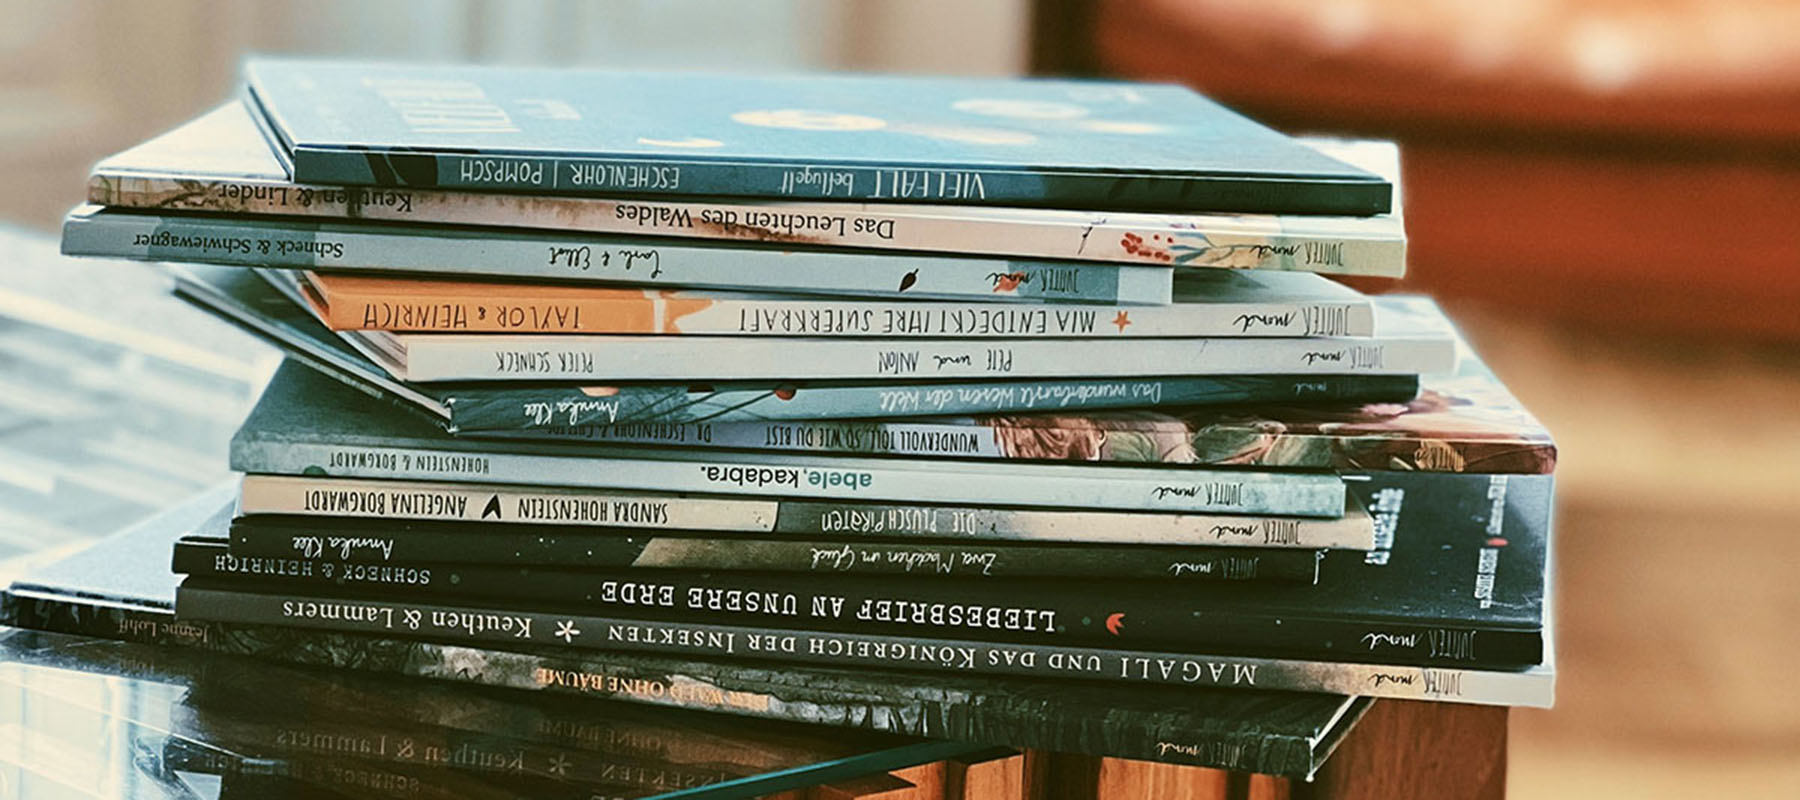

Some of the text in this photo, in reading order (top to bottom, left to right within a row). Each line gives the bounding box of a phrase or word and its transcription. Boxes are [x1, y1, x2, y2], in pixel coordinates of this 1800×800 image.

[460, 159, 680, 189] ESCHENLOHR POMPSCH
[867, 170, 985, 200] VIELFALT
[216, 184, 288, 207] Linder
[295, 187, 314, 208] &
[614, 204, 896, 240] Das Leuchten des Waldes
[132, 231, 344, 259] Schneck & Schwiewagner
[549, 246, 591, 271] Elliot
[362, 303, 581, 329] TAYLOR & HEINRICH
[738, 308, 1097, 334] MIA ENTDECKT IHRE SUPERKRAFT
[495, 352, 594, 374] PETER SCHNECK
[878, 349, 1012, 374] PETE und ANTON
[879, 391, 919, 410] Welt
[926, 389, 953, 408] der
[958, 387, 1014, 407] Wesen
[1132, 382, 1161, 404] Das
[523, 400, 619, 425] Annika Klee
[765, 426, 791, 446] BIST
[797, 427, 814, 447] DU
[817, 427, 842, 448] WIE
[846, 429, 861, 449] SO
[900, 431, 979, 453] WUNDERVOLL
[328, 452, 489, 475] HOHENSTEIN & BORGWARDT
[303, 490, 668, 525] SANDRA HOHENSTEIN ANGELINA BORGWARDT
[951, 512, 976, 535] DIE
[292, 536, 394, 560] Annika Klee
[213, 554, 431, 585] SCHNECK & HEINRICH
[601, 581, 1056, 632] LIEBESBRIEF AN UNSERE ERDE
[117, 619, 209, 643] Jeanne Lohff
[282, 602, 1257, 684] MAGALI UND DAS KÖNIGREICH DER INSEKTEN Keuthen & Lammers
[534, 667, 603, 693] BÄUME
[607, 675, 665, 698] OHNE
